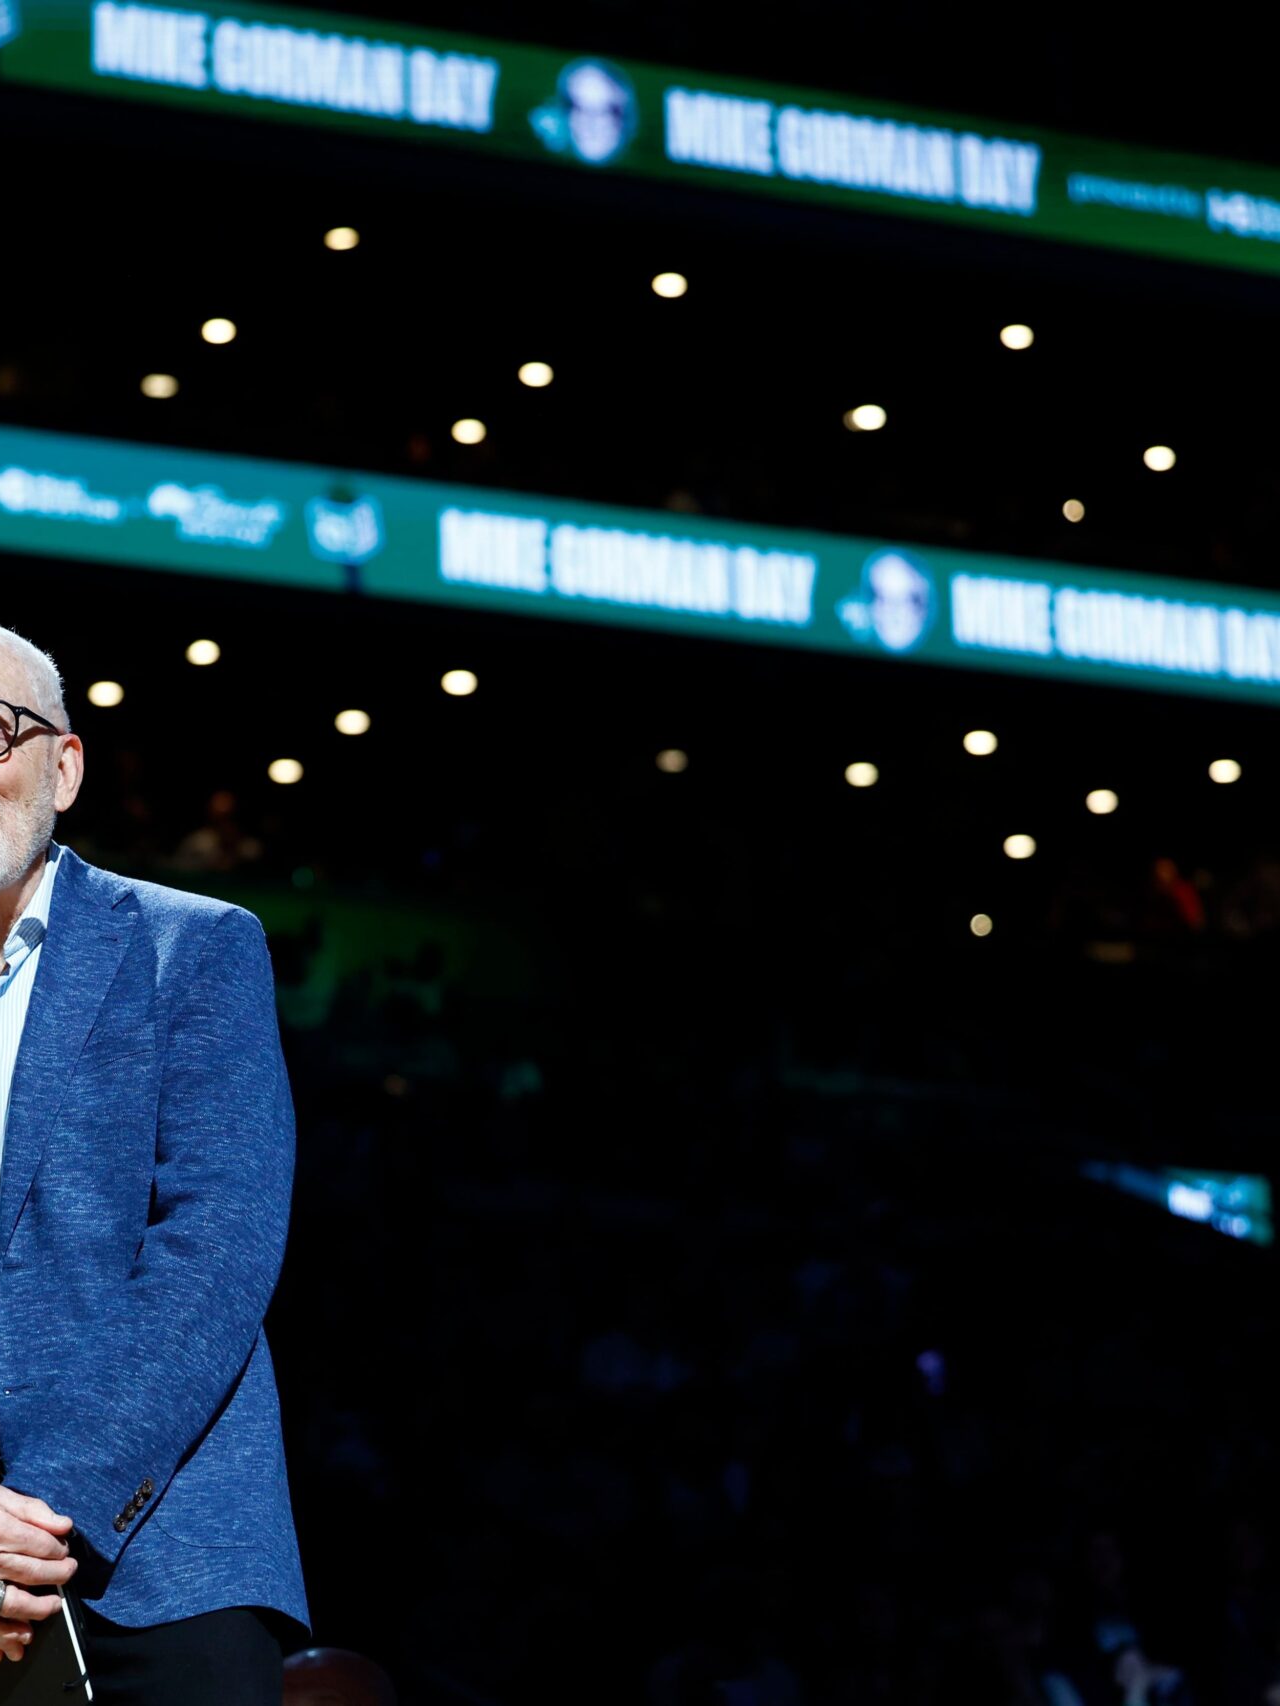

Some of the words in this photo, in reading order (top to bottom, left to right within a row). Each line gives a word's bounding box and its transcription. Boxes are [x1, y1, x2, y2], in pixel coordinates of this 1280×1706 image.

[94, 2, 207, 87] MIKE
[409, 51, 495, 125] DAY
[667, 91, 773, 171] MIKE
[958, 136, 1038, 208] DAY
[440, 509, 548, 592] MIKE
[732, 549, 815, 622] DAY
[951, 575, 1052, 654] MIKE
